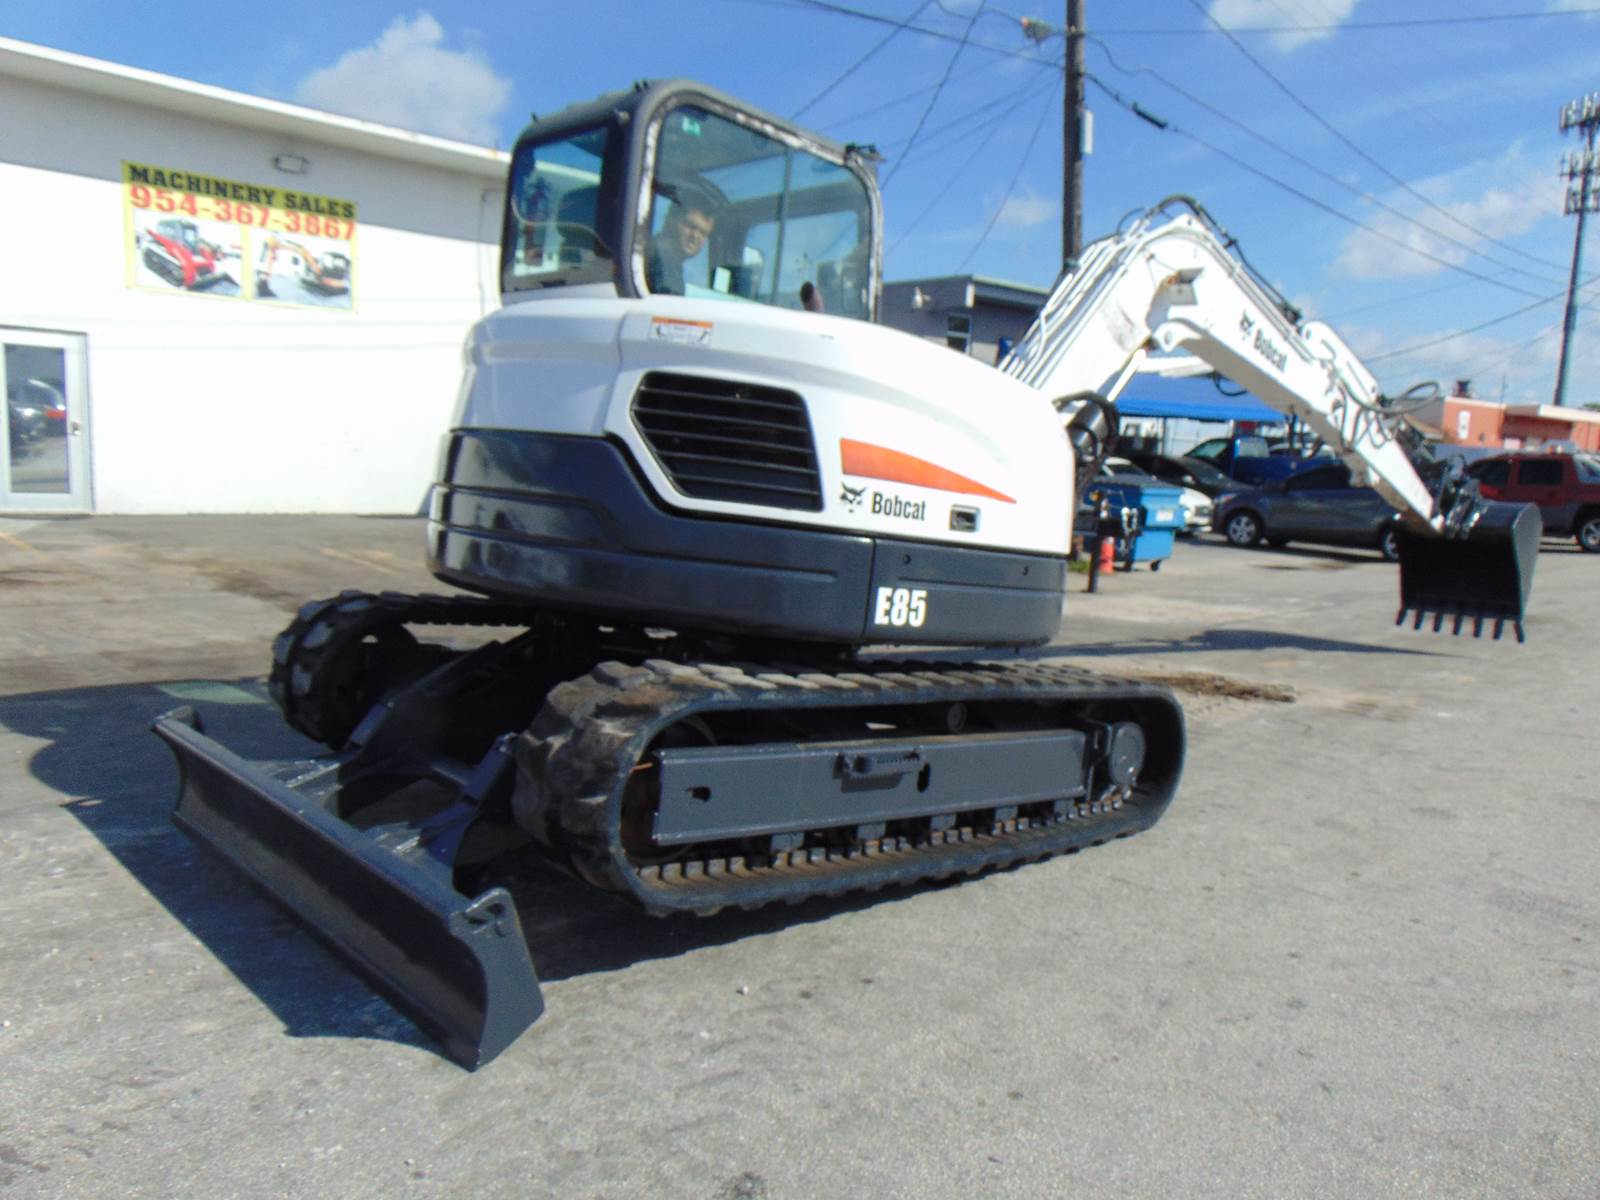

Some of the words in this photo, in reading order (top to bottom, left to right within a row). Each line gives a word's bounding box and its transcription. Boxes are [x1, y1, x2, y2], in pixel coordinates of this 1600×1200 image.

[129, 165, 276, 206] MACHINERY
[284, 194, 355, 218] SALES
[130, 184, 356, 240] 954-367-3867
[1253, 328, 1288, 373] Bobcat
[872, 491, 926, 521] Bobcat
[874, 586, 928, 627] E85
